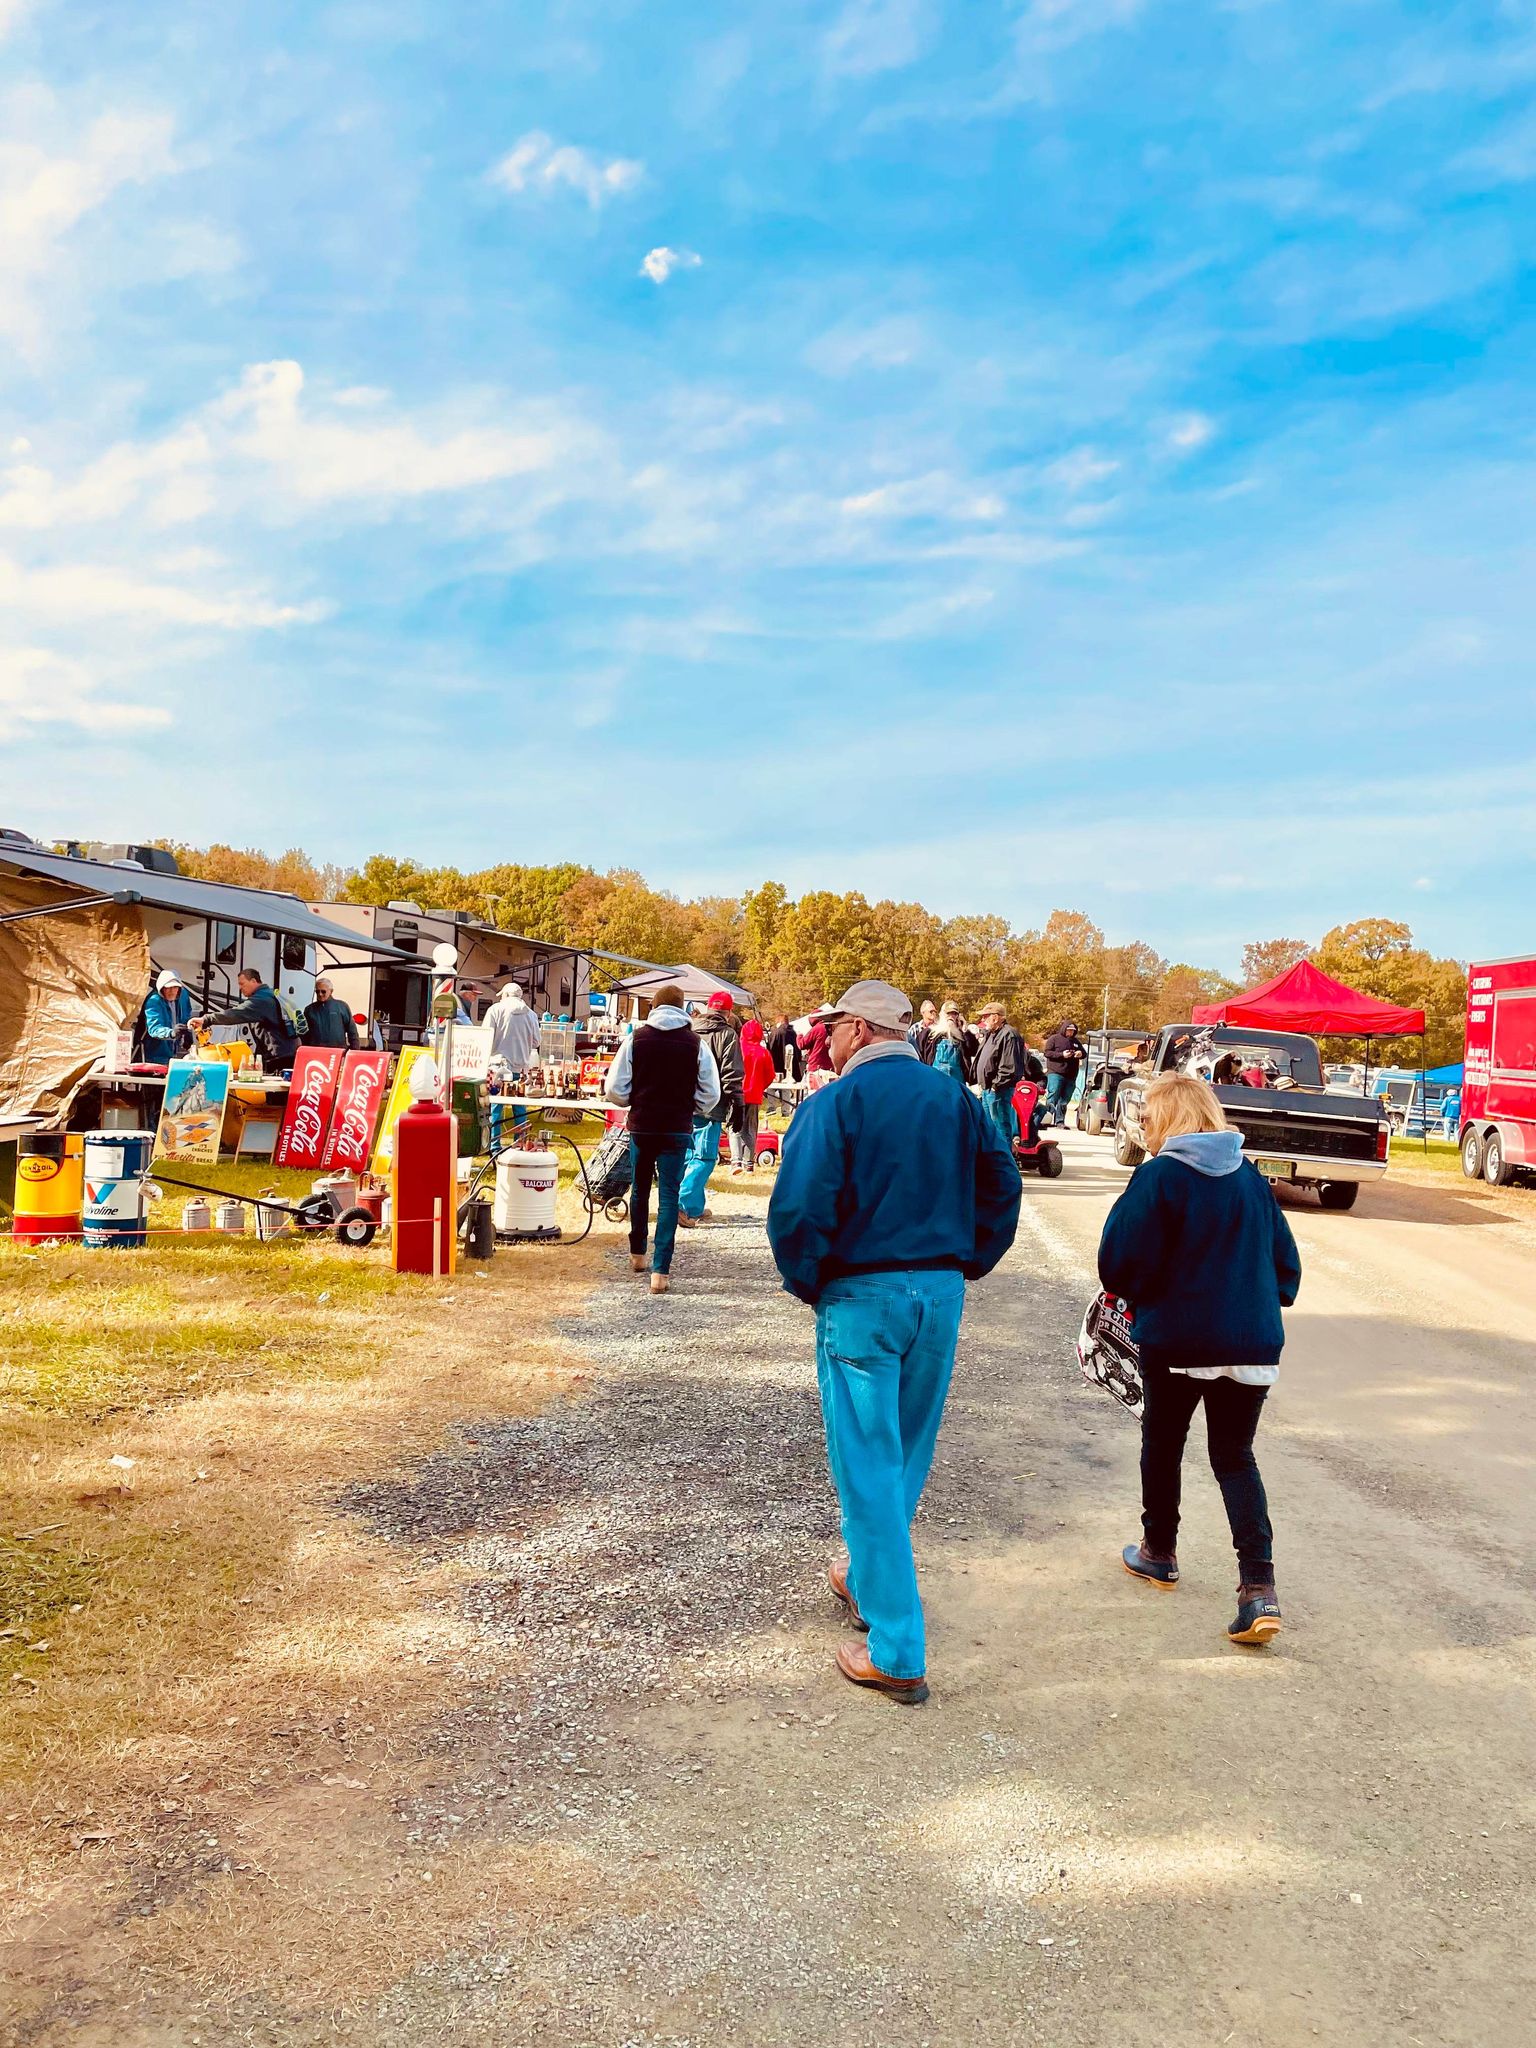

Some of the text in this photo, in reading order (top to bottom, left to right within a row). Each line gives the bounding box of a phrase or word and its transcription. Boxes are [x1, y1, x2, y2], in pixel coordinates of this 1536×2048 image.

[290, 1060, 332, 1158] Coca-Cola
[336, 1063, 379, 1161] Coca-Cola
[279, 1135, 290, 1162] BOTTLES
[325, 1138, 336, 1165] BOTTLES
